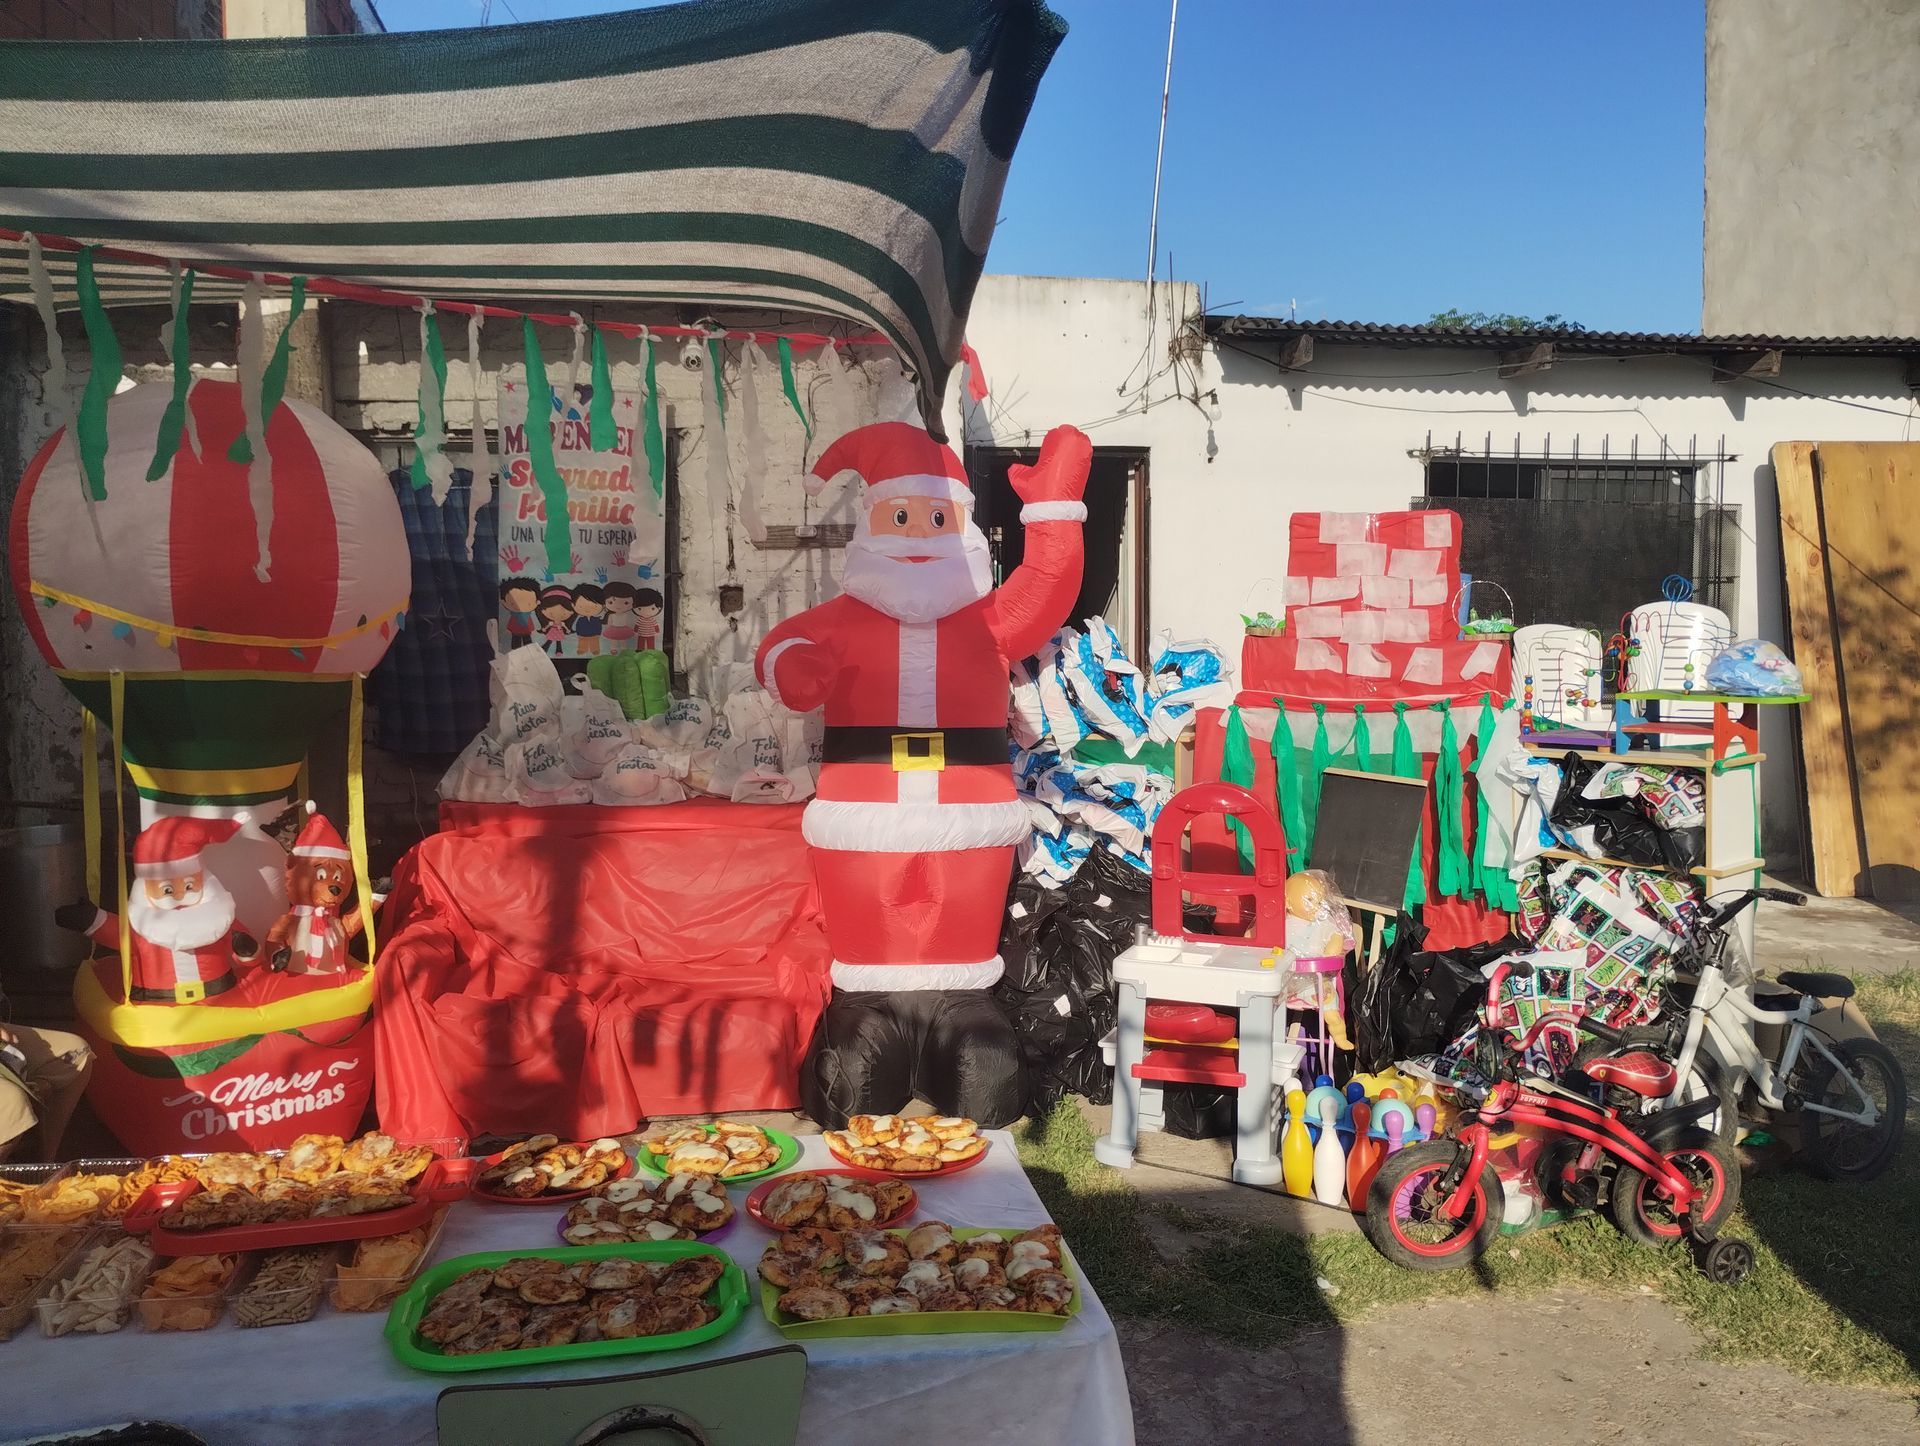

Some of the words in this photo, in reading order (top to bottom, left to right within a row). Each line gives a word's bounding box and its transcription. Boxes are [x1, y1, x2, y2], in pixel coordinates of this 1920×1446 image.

[510, 525, 535, 544] UNA
[578, 528, 593, 545] TU
[597, 529, 637, 547] ESPERA
[751, 734, 781, 754] Feli
[209, 1069, 324, 1106] Merry
[181, 1081, 346, 1140] Christmas
